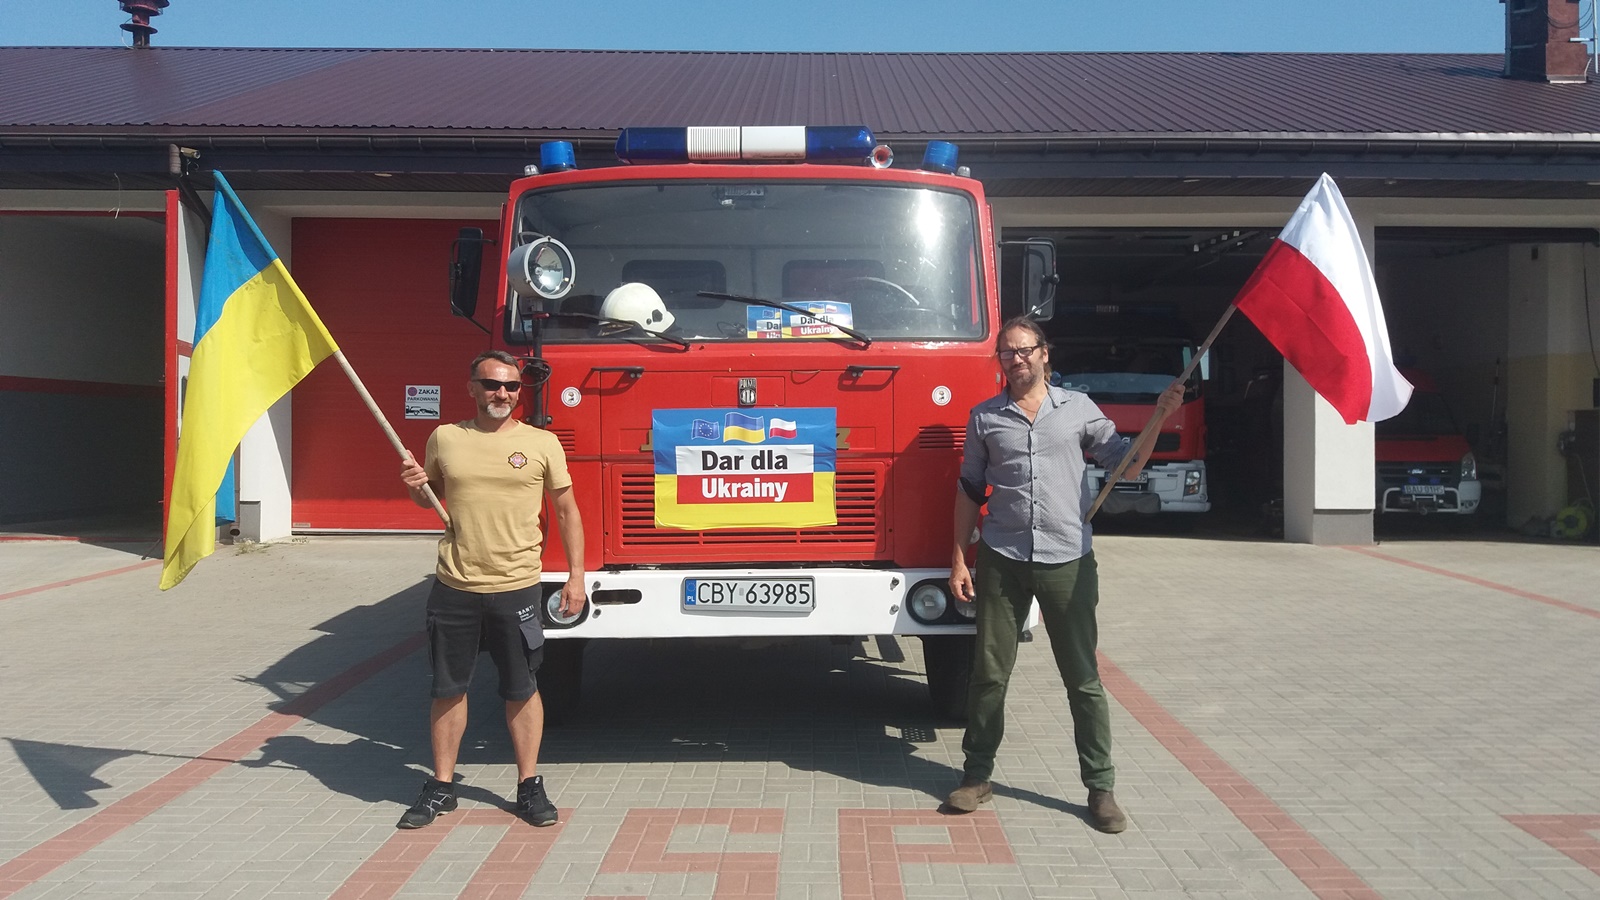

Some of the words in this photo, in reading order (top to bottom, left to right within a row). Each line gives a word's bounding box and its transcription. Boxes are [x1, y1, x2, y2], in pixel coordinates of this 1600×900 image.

[766, 321, 782, 330] Da
[800, 326, 834, 335] Ukrainy
[701, 450, 744, 471] Dar
[750, 449, 788, 470] dla
[701, 477, 789, 502] Ukrainy
[698, 582, 738, 604] CBY
[745, 583, 811, 605] 63985
